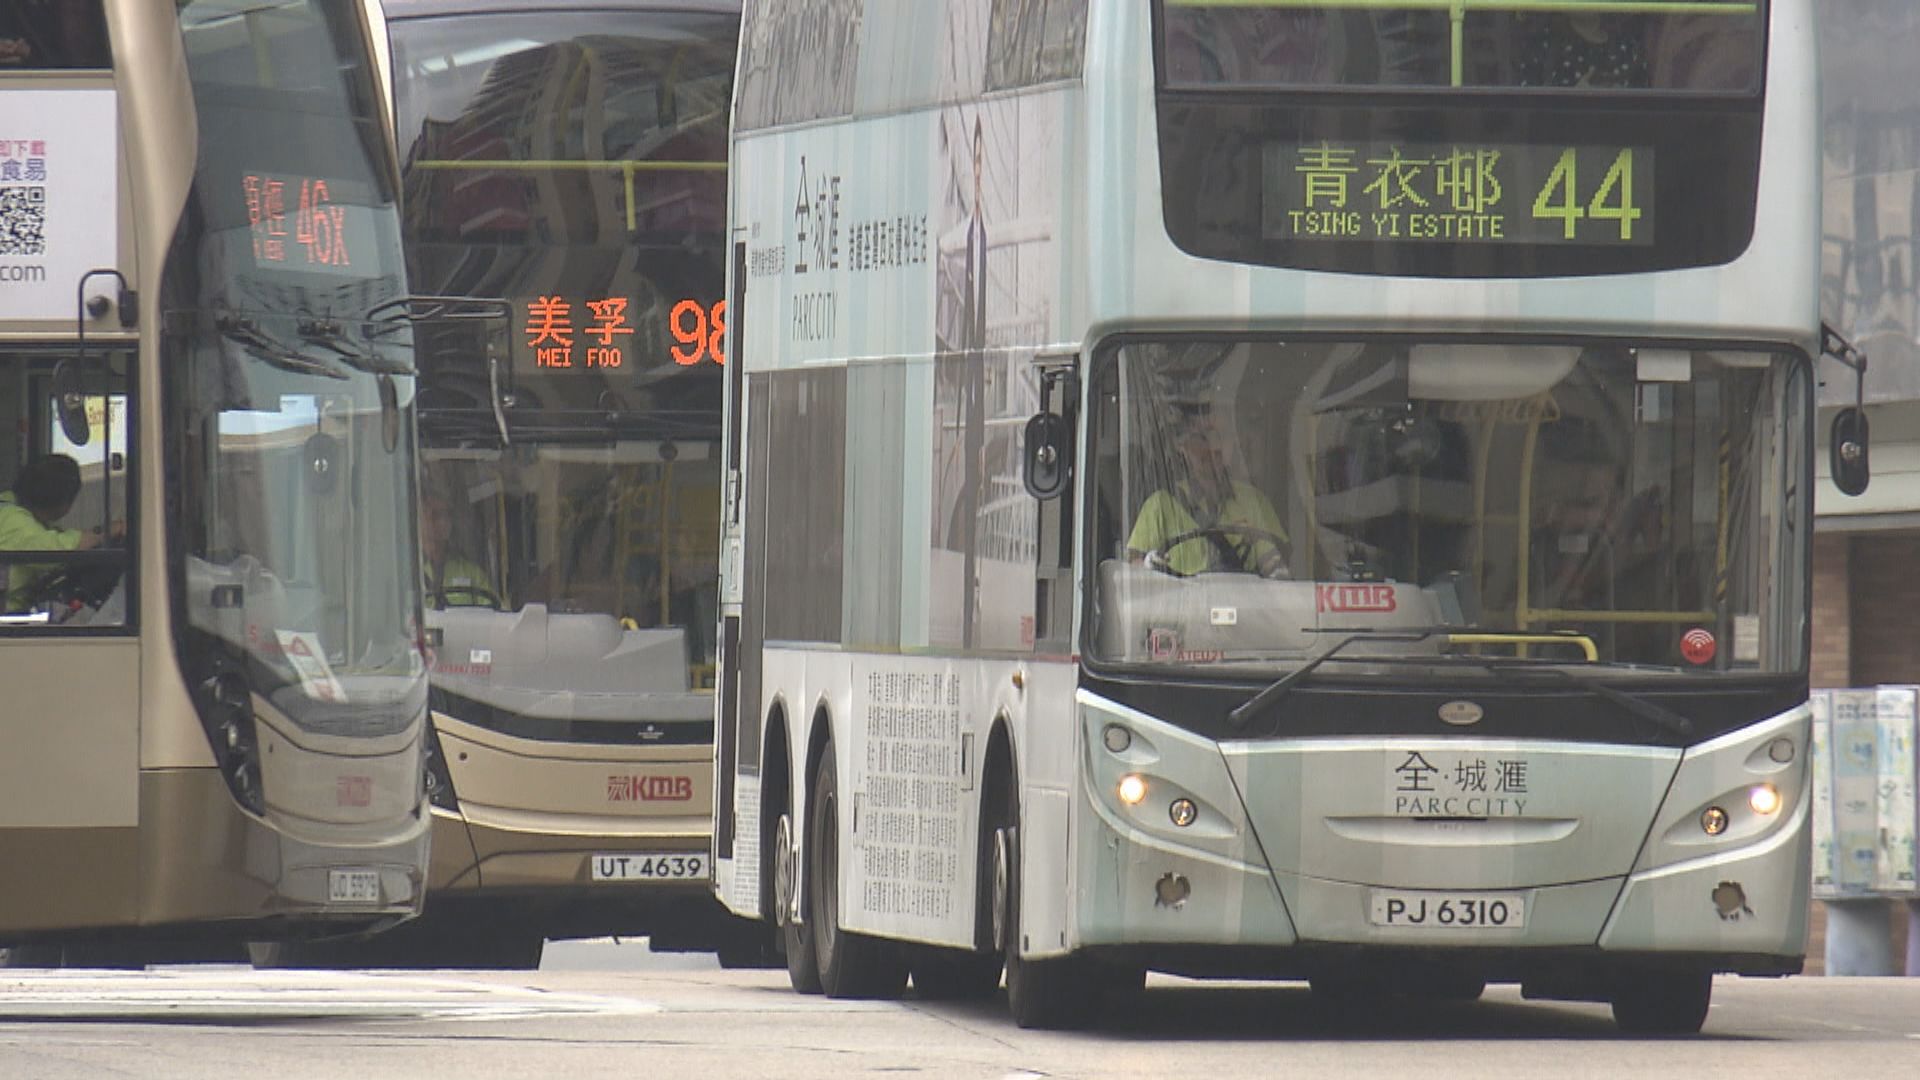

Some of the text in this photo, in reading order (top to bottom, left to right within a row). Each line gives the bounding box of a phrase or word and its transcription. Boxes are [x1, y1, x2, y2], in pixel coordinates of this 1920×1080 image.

[1295, 140, 1502, 214] 青衣邨
[1532, 147, 1641, 240] 44
[1288, 211, 1504, 238] TSING YI ESTATE
[525, 296, 635, 347] 美孚
[537, 348, 622, 367] MEI FOO
[1315, 585, 1397, 613] KMB
[632, 776, 693, 801] KMB
[1396, 797, 1527, 816] PARC CITY
[600, 858, 701, 878] UT 4639
[1387, 900, 1508, 925] PJ 6310
